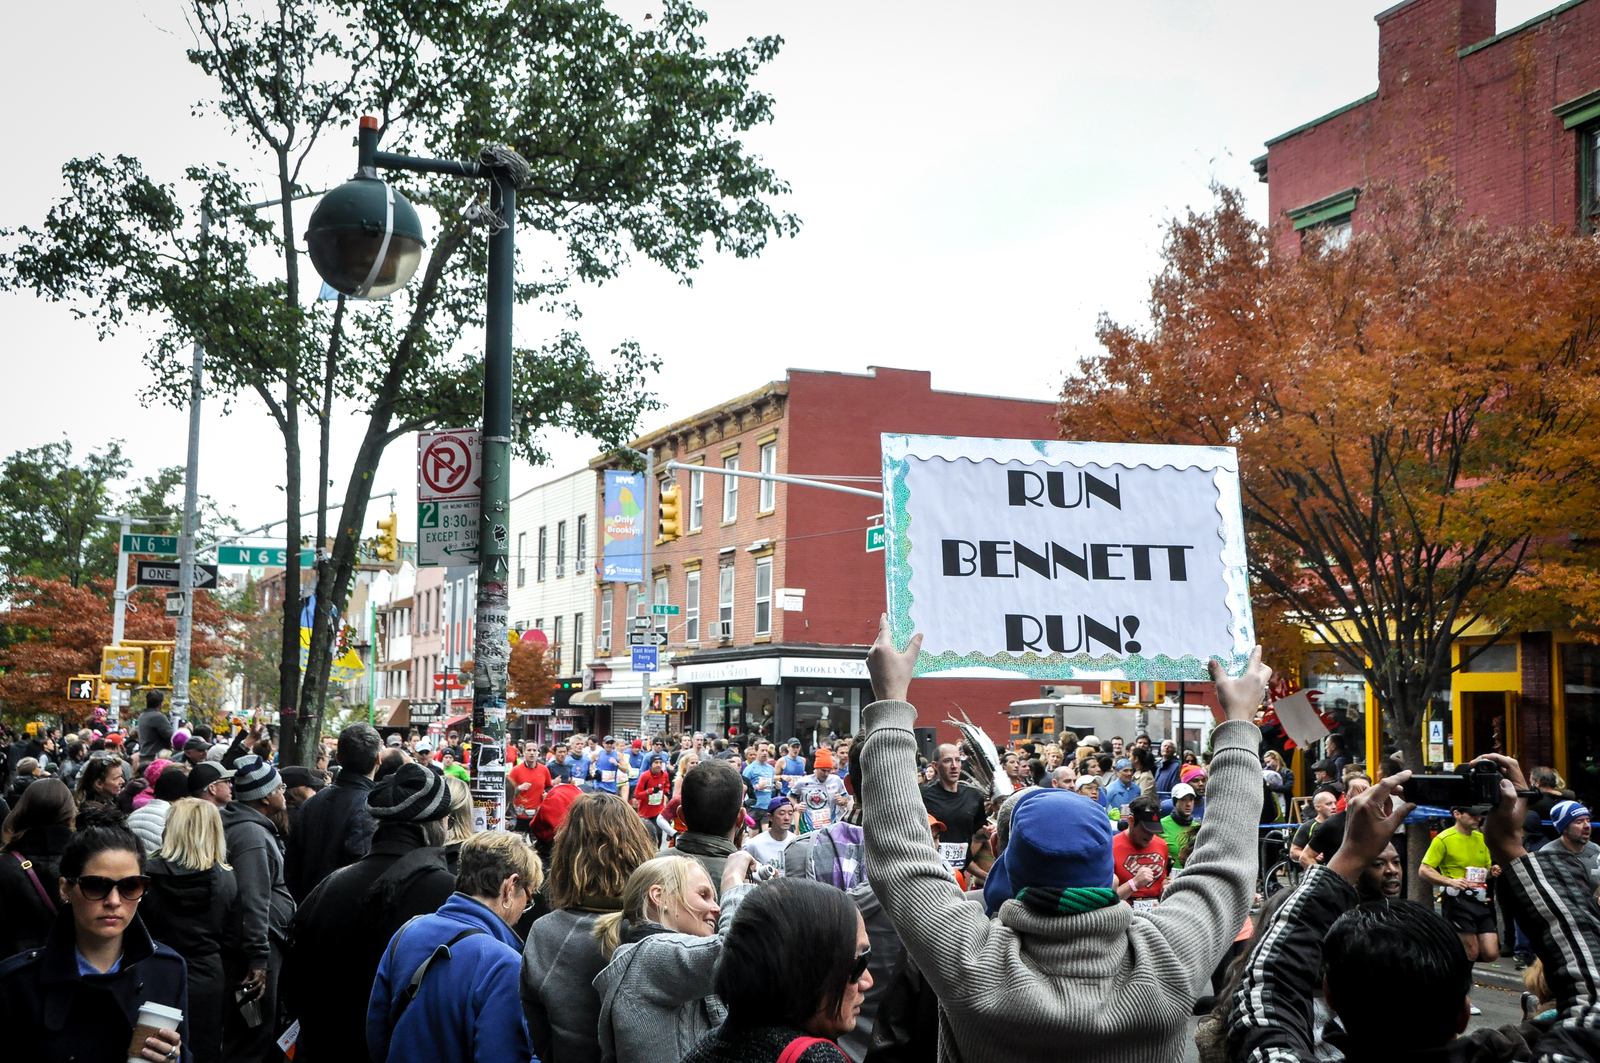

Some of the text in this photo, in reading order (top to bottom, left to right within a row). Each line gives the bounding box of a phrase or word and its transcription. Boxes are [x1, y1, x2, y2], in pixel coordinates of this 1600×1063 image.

[1007, 470, 1121, 511] RUN
[422, 503, 436, 527] 2
[614, 515, 634, 526] Only
[607, 525, 641, 536] Brooklyn
[426, 531, 458, 543] EXCEPT
[131, 537, 140, 551] N
[147, 538, 156, 552] 6
[239, 550, 250, 562] N
[258, 551, 269, 563] 6
[941, 539, 1194, 581] BENNETT
[149, 569, 172, 580] ONE
[656, 606, 661, 614] N
[663, 606, 669, 614] 6
[1005, 613, 1141, 654] RUN!
[793, 665, 846, 674] BROOKLYN
[555, 717, 573, 725] ATM
[1432, 724, 1441, 737] A
